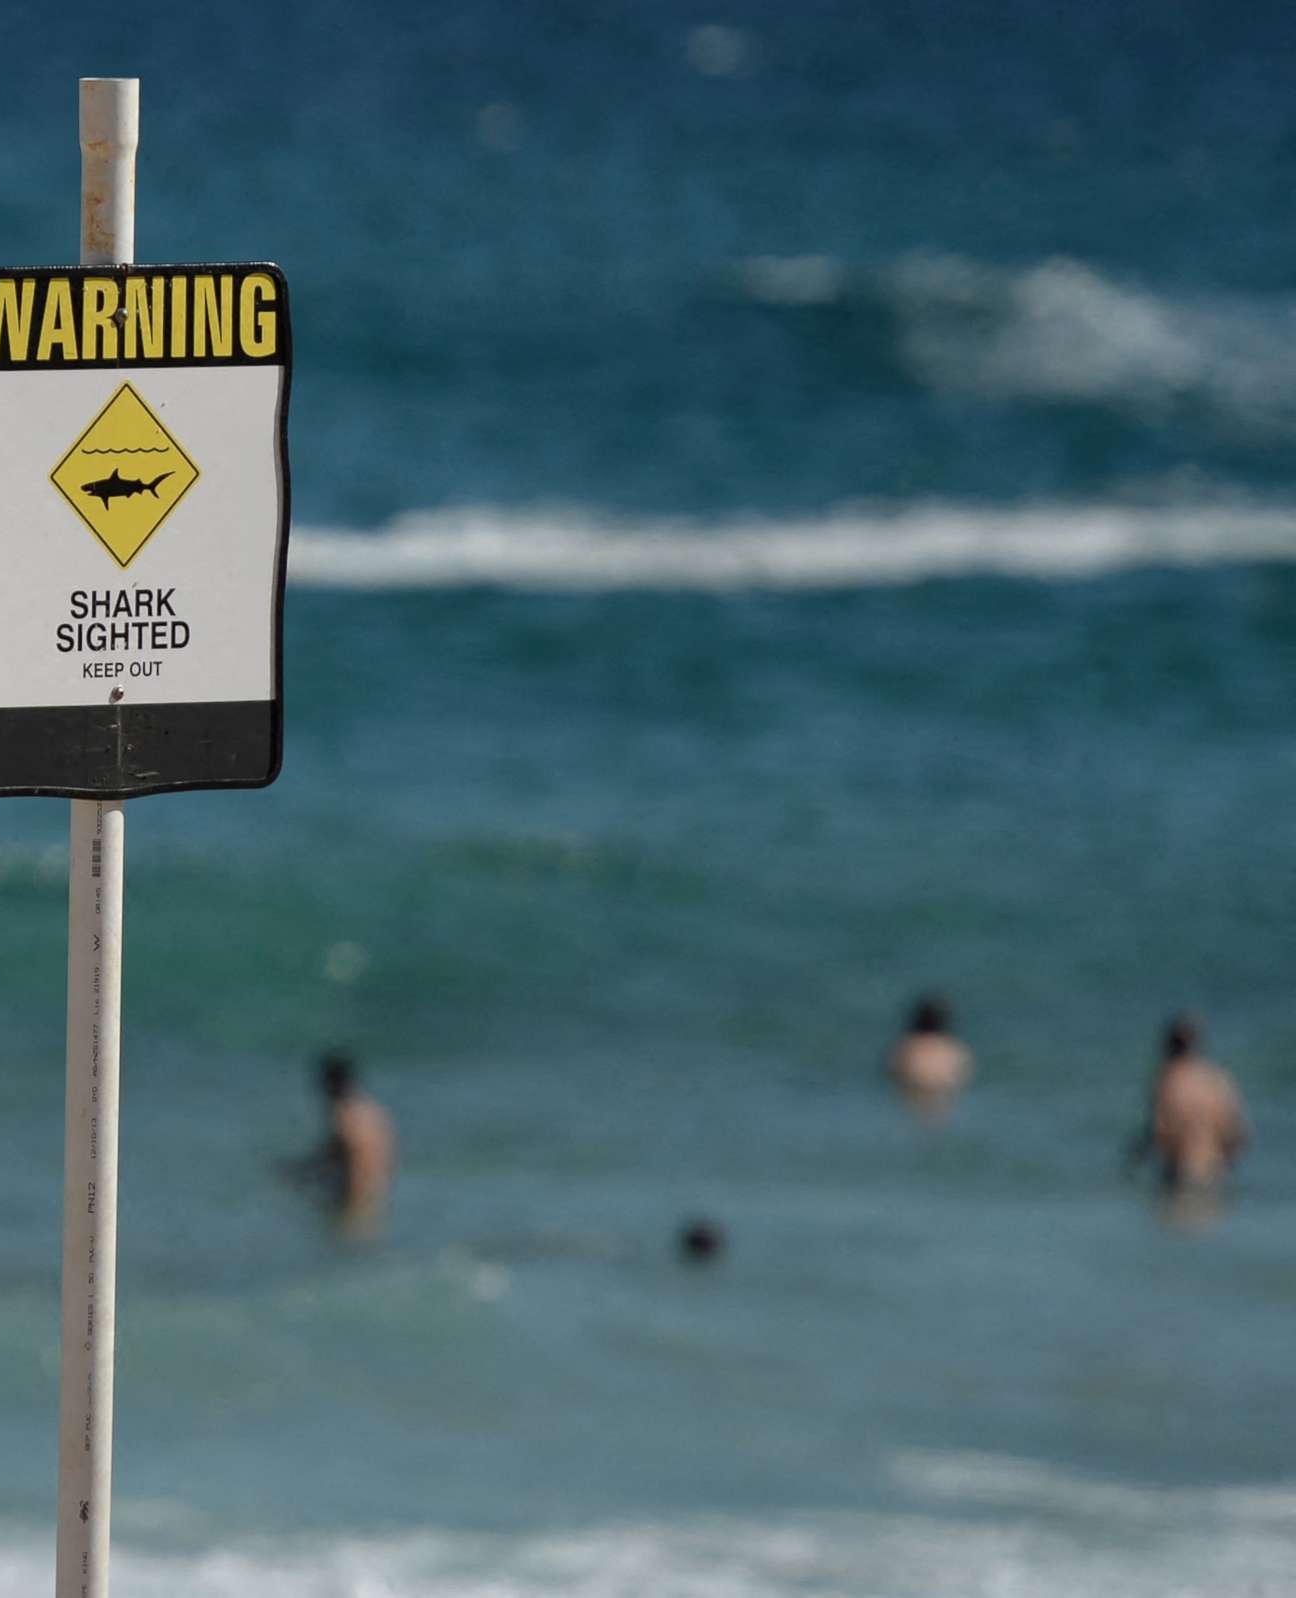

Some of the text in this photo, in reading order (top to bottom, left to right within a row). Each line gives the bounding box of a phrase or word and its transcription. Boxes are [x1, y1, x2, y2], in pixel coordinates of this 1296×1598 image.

[70, 588, 176, 619] SHARK
[56, 621, 190, 652] SIGHTED
[82, 661, 163, 679] KEEP OUT
[86, 1180, 96, 1214] PN12
